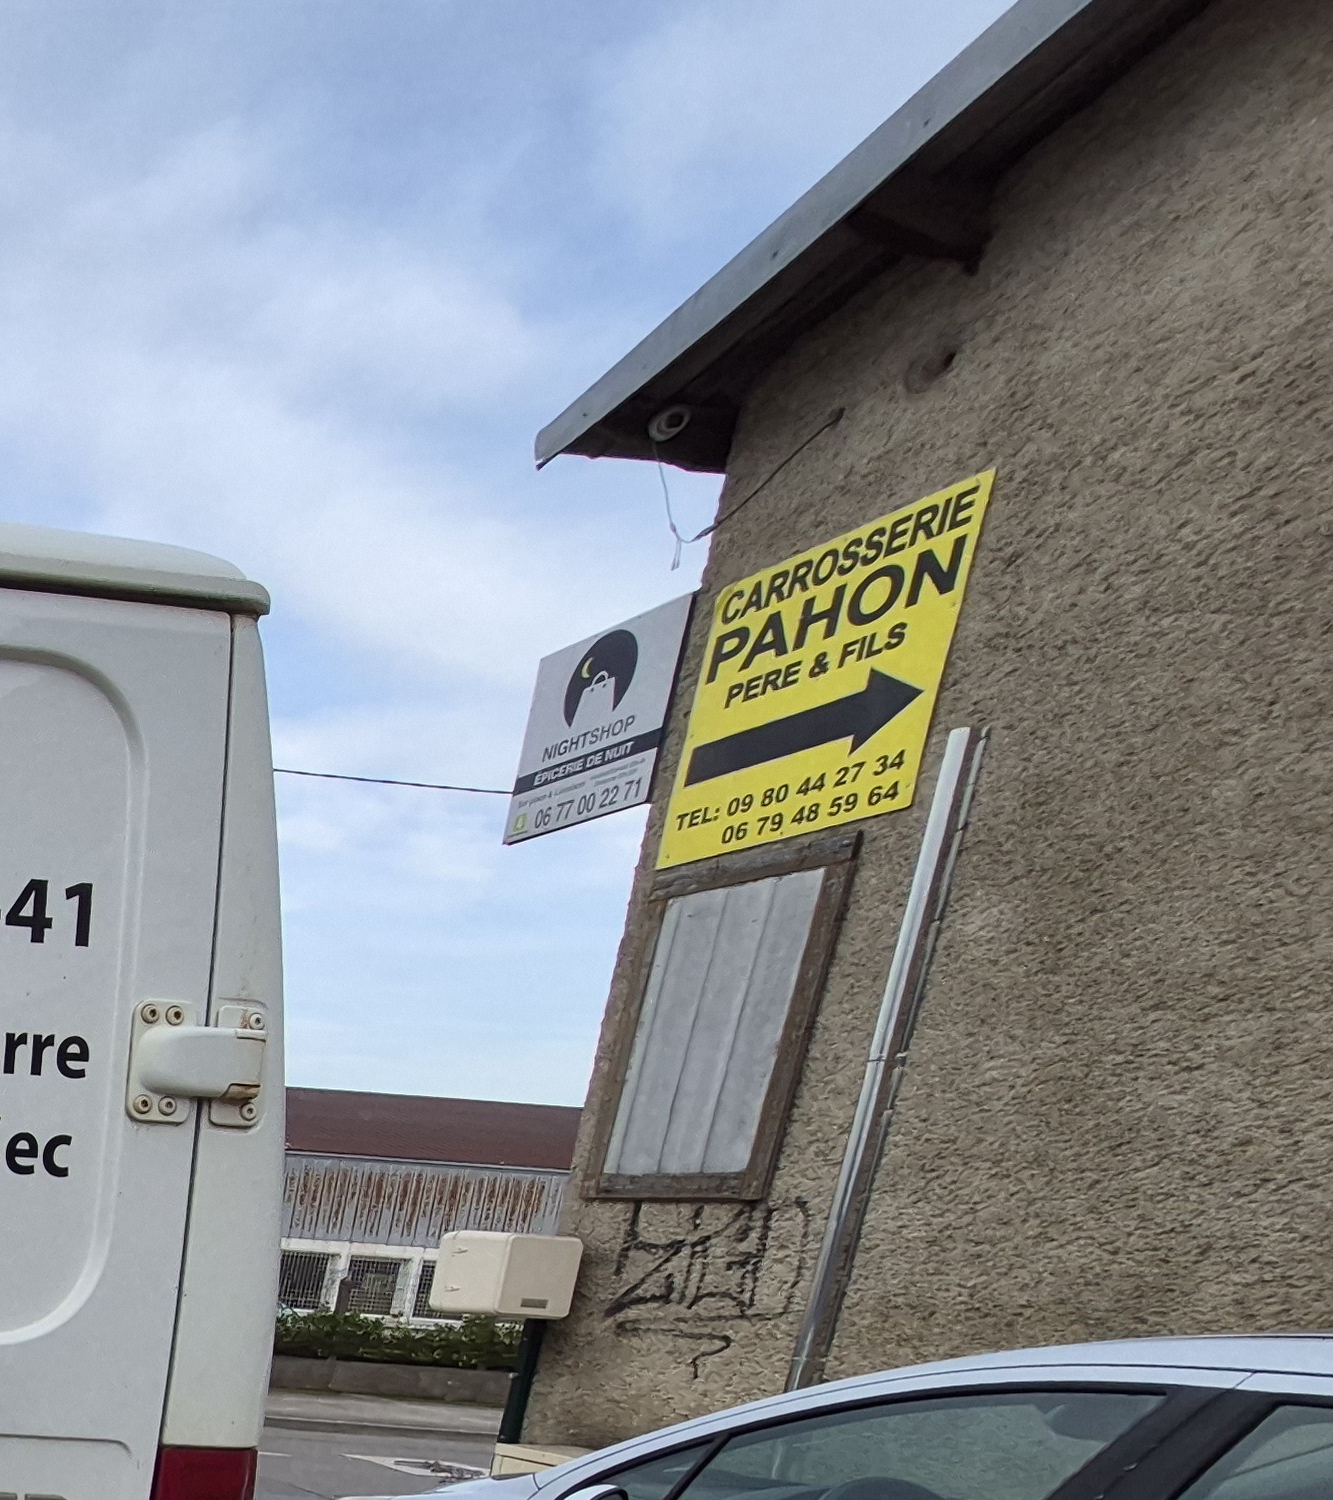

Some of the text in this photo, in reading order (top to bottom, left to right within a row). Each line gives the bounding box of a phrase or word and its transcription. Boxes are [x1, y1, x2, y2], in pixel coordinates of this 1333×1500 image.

[721, 485, 980, 625] CARROSSERIE
[706, 534, 968, 685] PAHON
[725, 622, 908, 709] PERE & FILS
[542, 715, 636, 763] NIGHTSHOP
[586, 753, 604, 768] DE
[604, 741, 635, 761] NUIT
[535, 806, 552, 829] 06
[556, 799, 575, 823] 77
[577, 792, 596, 816] 00
[598, 784, 620, 809] 22
[624, 777, 643, 801] 71
[676, 749, 907, 831] TEL: 09 80 44 27 34
[721, 780, 901, 845] 06 79 48 59 64
